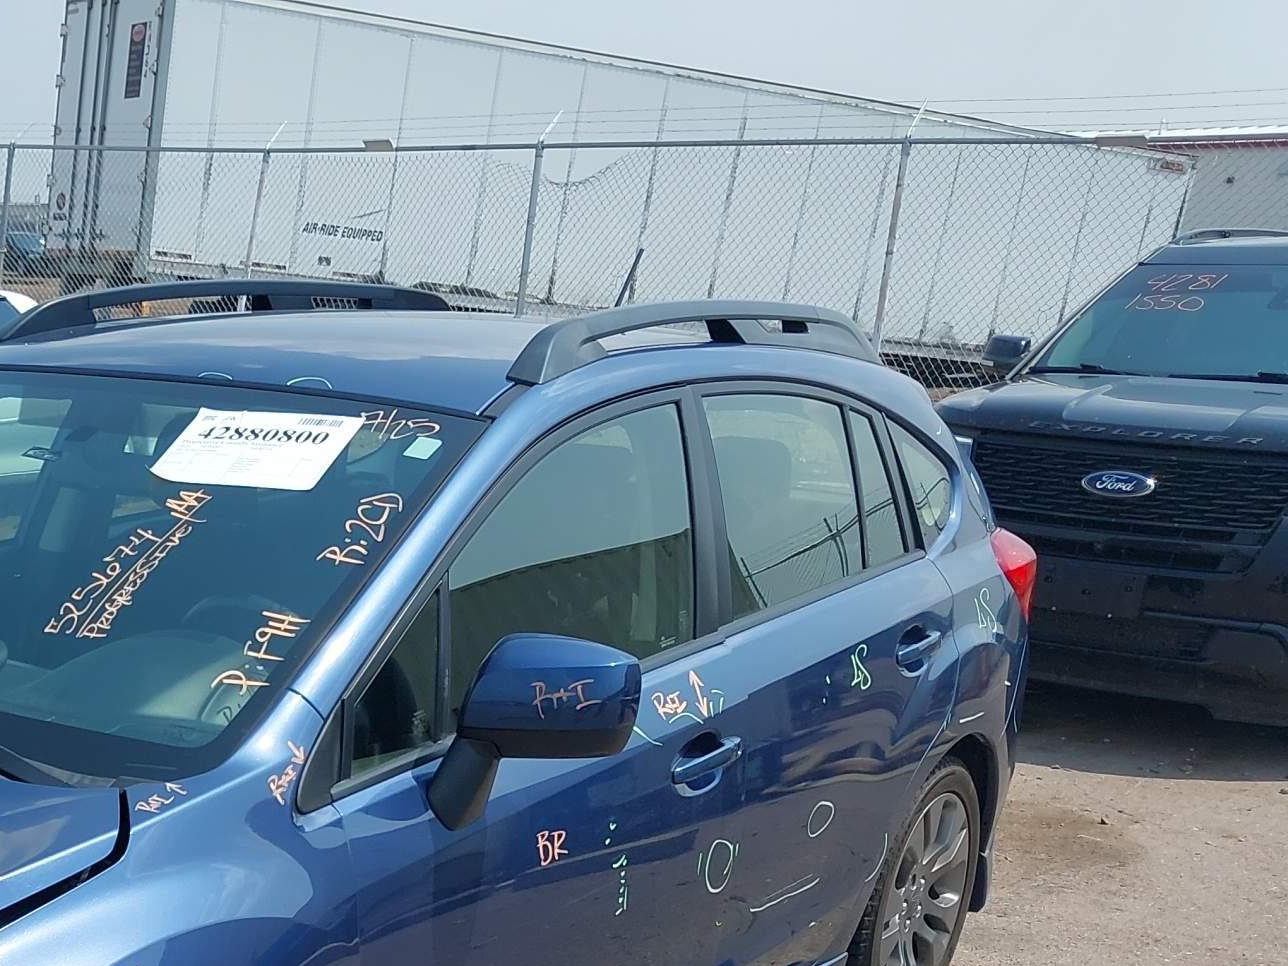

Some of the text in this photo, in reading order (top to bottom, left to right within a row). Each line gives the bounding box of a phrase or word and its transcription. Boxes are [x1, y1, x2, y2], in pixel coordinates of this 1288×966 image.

[341, 226, 383, 242] EQUIPPED
[1147, 274, 1229, 291] 4281
[1124, 292, 1204, 312] 1550
[197, 425, 330, 445] 42880800
[1028, 420, 1263, 446] EXPLORER
[1095, 474, 1137, 492] Ford
[536, 830, 569, 867] BR
